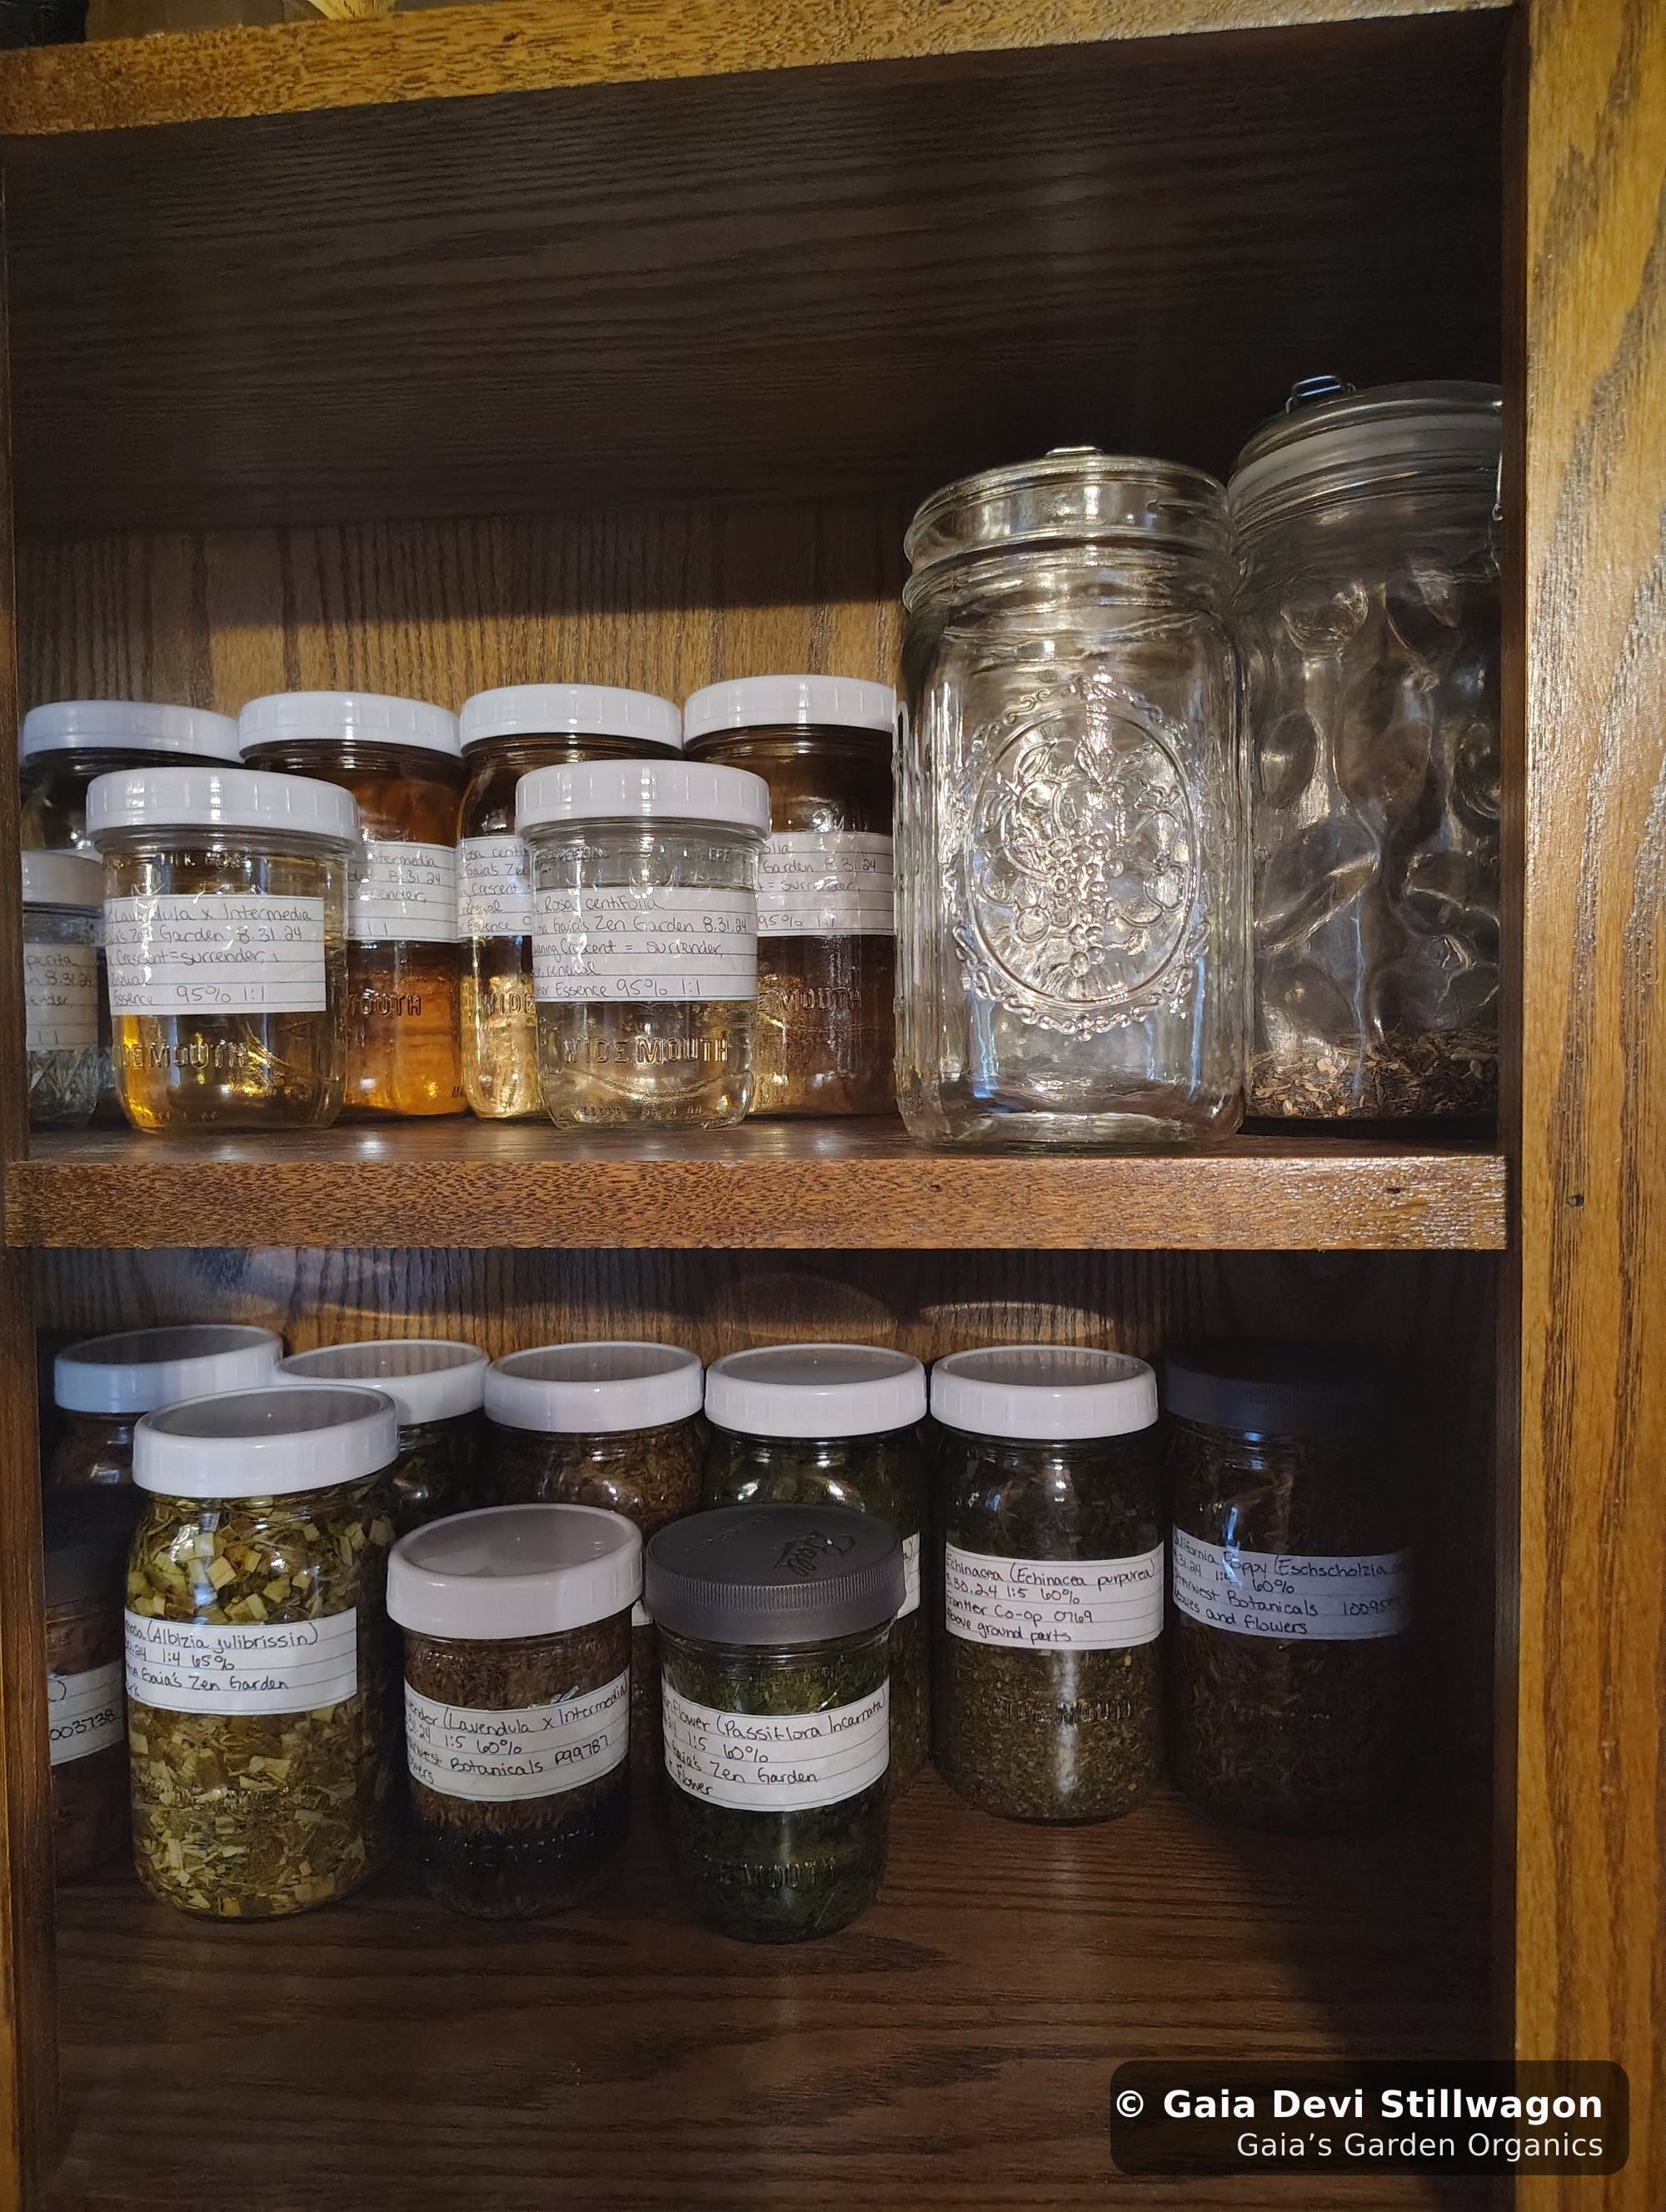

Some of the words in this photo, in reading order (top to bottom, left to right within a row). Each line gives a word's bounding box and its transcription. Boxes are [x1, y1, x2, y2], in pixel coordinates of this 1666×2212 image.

[763, 859, 815, 874] Garden
[222, 902, 313, 922] Intermedia
[545, 895, 578, 914] Rosa
[594, 916, 626, 931] Zen
[633, 915, 695, 932] Garden
[703, 915, 747, 934] 8.31.24
[758, 915, 803, 929] 95%
[159, 924, 226, 943] Garden
[237, 925, 302, 944] 8.31.24
[176, 985, 232, 1004] 95%
[243, 985, 265, 1002] 1:1
[556, 981, 611, 998] Essence
[616, 978, 668, 996] 95%
[681, 979, 701, 996] 1:1
[563, 1037, 630, 1064] WIDE
[635, 1035, 729, 1065] MOUTH
[1006, 1585, 1029, 1598] 1:5
[1040, 1588, 1080, 1605] 60%
[1252, 1578, 1294, 1595] 60%
[1227, 1589, 1319, 1617] Botanicals
[1205, 1608, 1235, 1625] and
[977, 1622, 1024, 1639] ground
[1030, 1632, 1073, 1645] parts
[162, 1648, 181, 1666] 1:4
[191, 1654, 236, 1671] 65%
[141, 1666, 182, 1688] Gaia's
[188, 1675, 221, 1691] Zen
[229, 1675, 290, 1692] Garden
[444, 1734, 466, 1749] 1:5
[476, 1739, 522, 1756] 60%
[687, 1731, 708, 1751] 1:5
[722, 1743, 769, 1764] 60%
[451, 1757, 544, 1776] Botanicals
[710, 1760, 746, 1784] Zen
[756, 1766, 819, 1784] Garden
